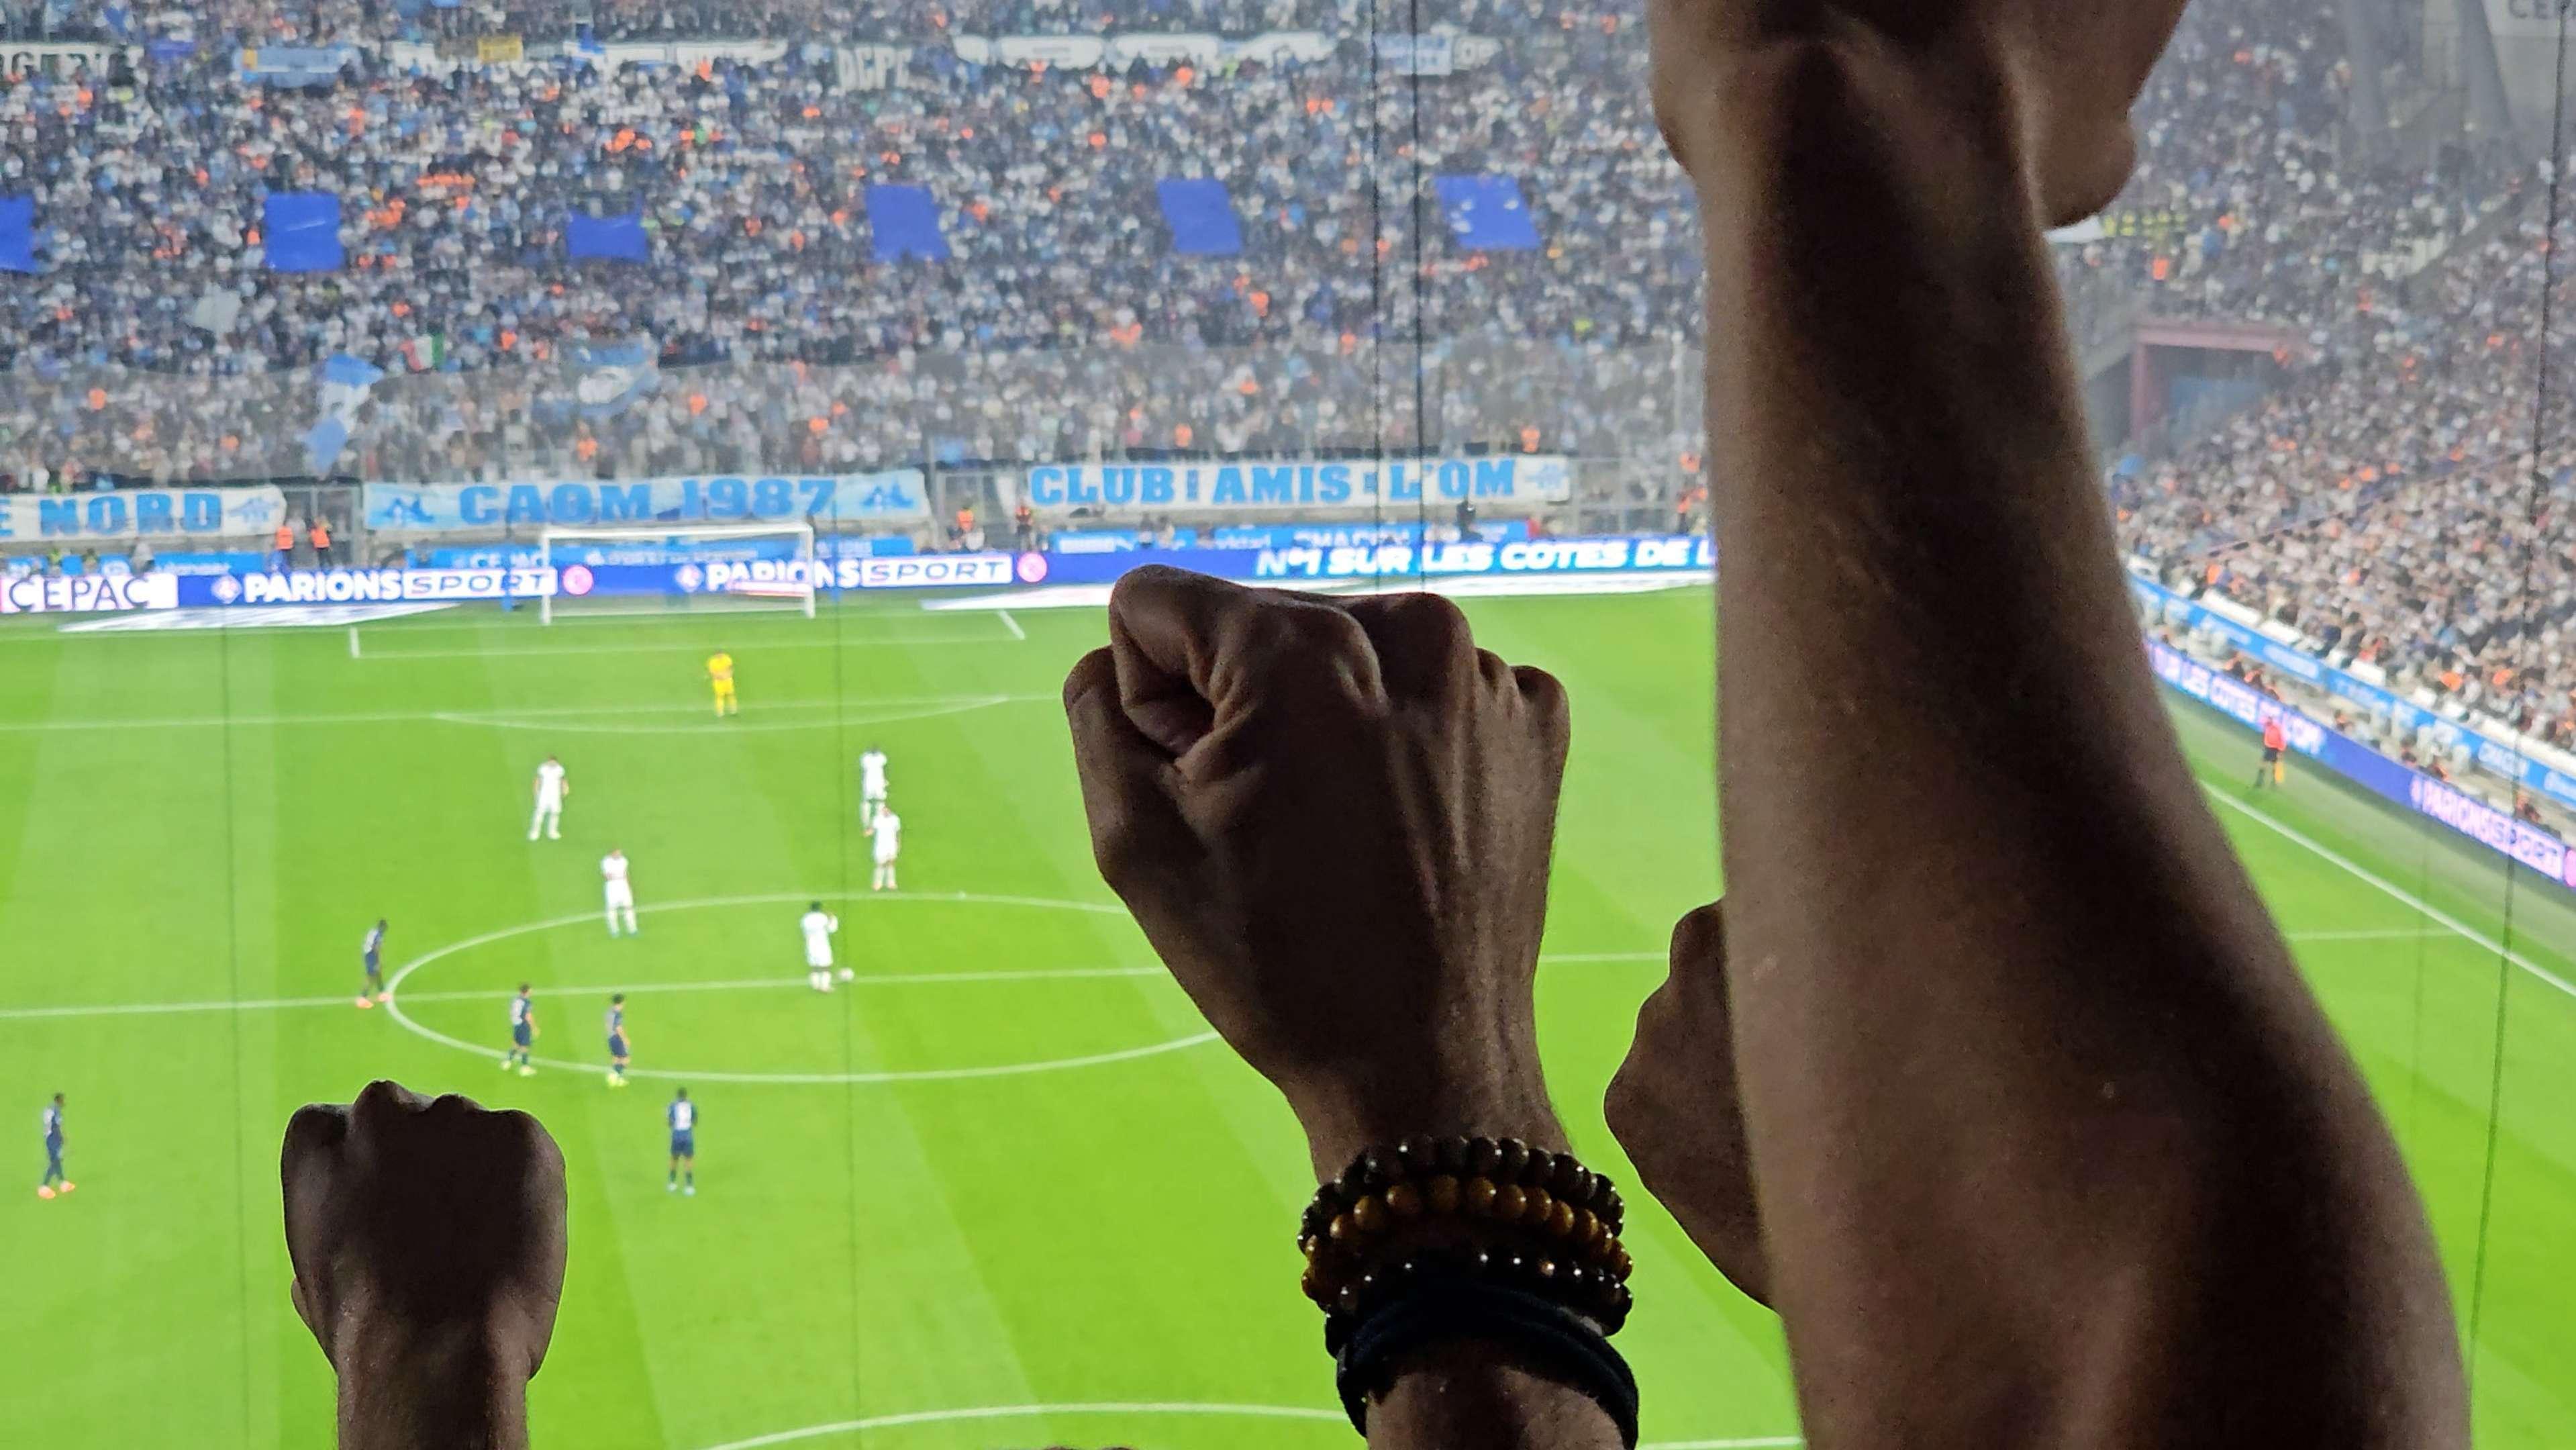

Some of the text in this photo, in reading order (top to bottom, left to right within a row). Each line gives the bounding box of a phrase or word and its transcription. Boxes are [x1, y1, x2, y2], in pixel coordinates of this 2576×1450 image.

[1031, 465, 1175, 504] CLUB
[1212, 465, 1350, 503] AMIS
[1389, 458, 1516, 499] L'OM
[39, 492, 223, 536] NORD
[459, 477, 838, 525] CAOM 1987
[706, 557, 860, 591] PARIONS
[871, 560, 1006, 581] SPORT
[1328, 544, 1413, 575] SUR
[1422, 542, 1495, 573] LES
[1500, 540, 1628, 569] COTES
[1635, 539, 1690, 567] DE
[9, 577, 151, 610] CEPAC
[243, 570, 550, 602] PARIONS SPORT
